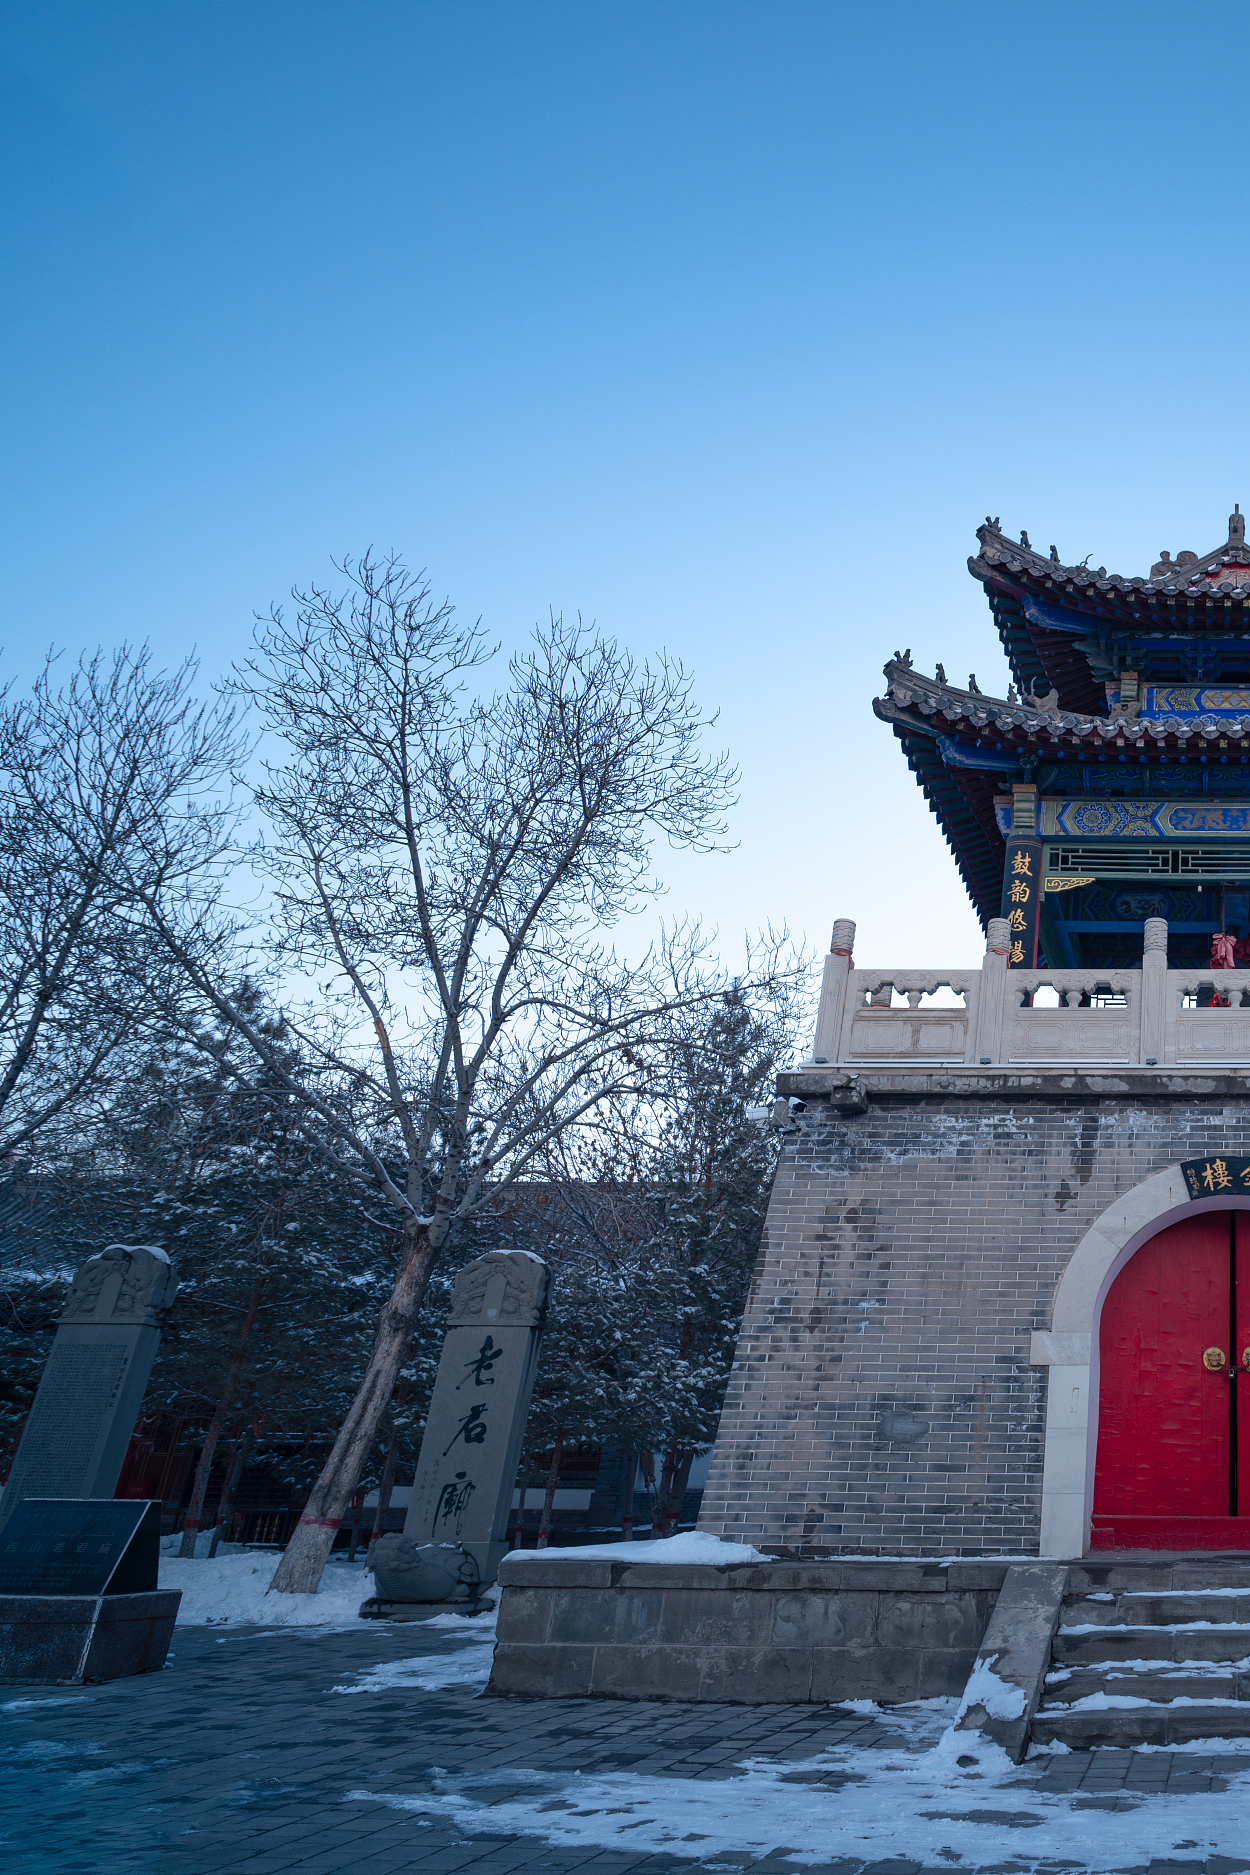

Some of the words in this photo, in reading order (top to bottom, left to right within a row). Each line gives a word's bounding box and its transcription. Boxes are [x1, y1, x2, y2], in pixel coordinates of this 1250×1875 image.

[4, 1541, 113, 1554] 西山老君庙
